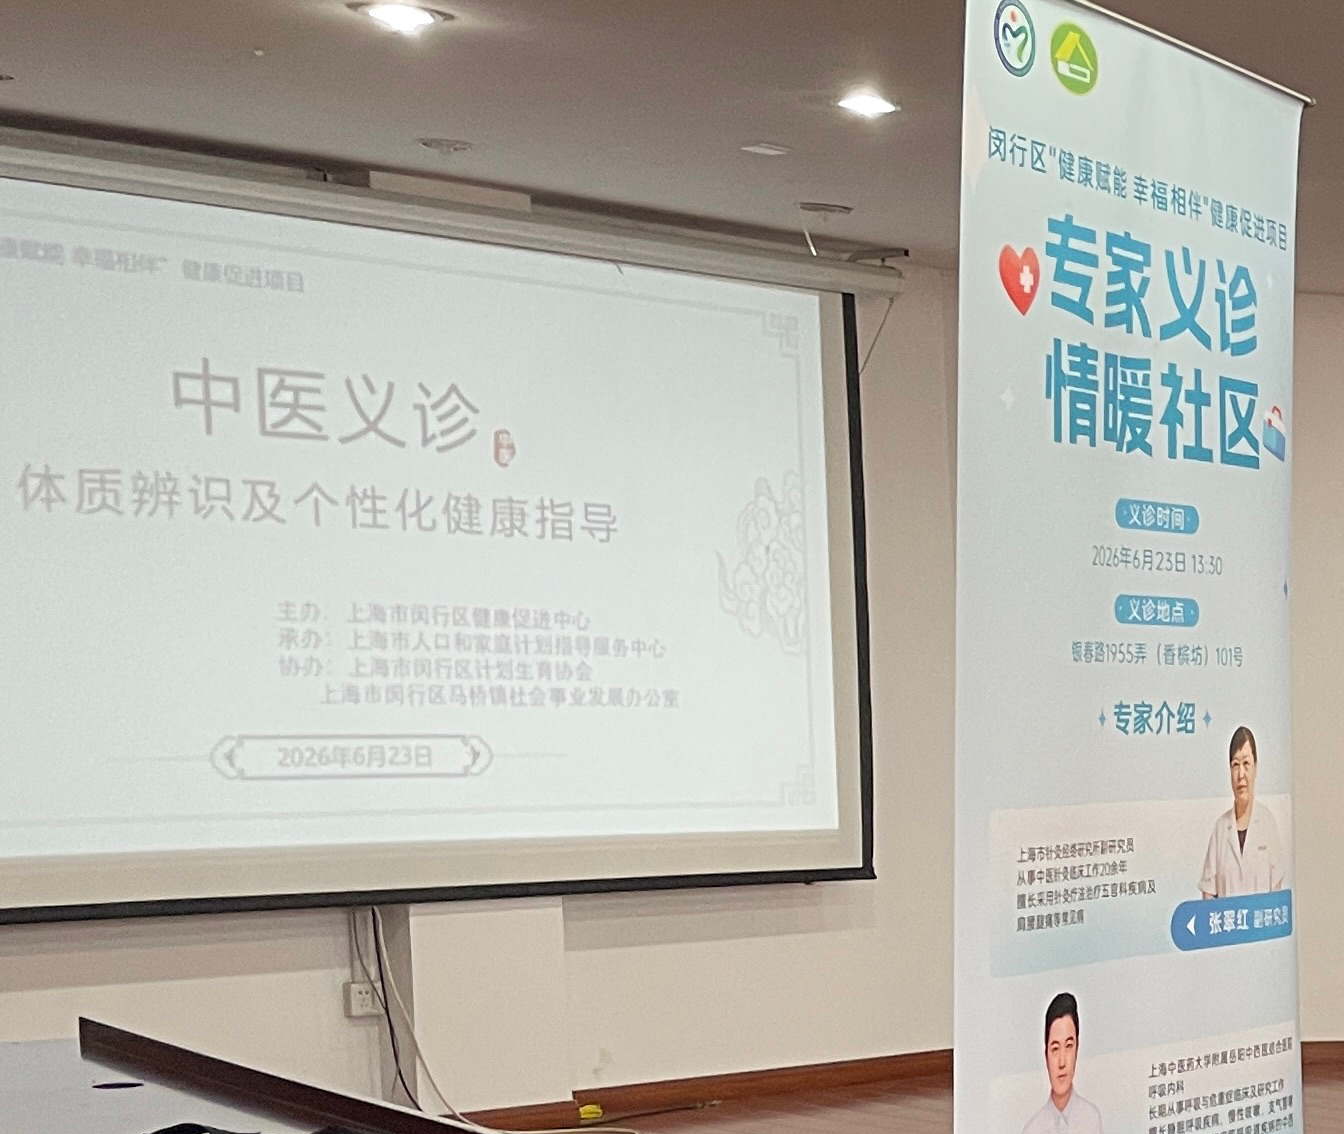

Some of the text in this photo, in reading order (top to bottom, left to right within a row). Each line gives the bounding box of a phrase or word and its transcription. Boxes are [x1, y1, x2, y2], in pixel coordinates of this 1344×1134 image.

[1044, 214, 1258, 357] 专家义诊
[171, 357, 481, 453] 中医义诊
[1045, 338, 1260, 470] 情暖社区
[17, 464, 619, 543] 体质辨识及个性化健康指导
[1128, 503, 1185, 531] 义诊时间
[1092, 545, 1223, 576] 2026年6月23日 13:30
[346, 602, 592, 631] 上海市闵行区健康促进中心
[1128, 598, 1185, 623] 义诊地点
[347, 631, 667, 659] 上海市人口和家庭计划指导服务中心
[348, 657, 593, 682] 上海市闵行区计划生育协会
[1113, 701, 1196, 736] 专家介绍
[277, 745, 432, 769] 2026年6月23日
